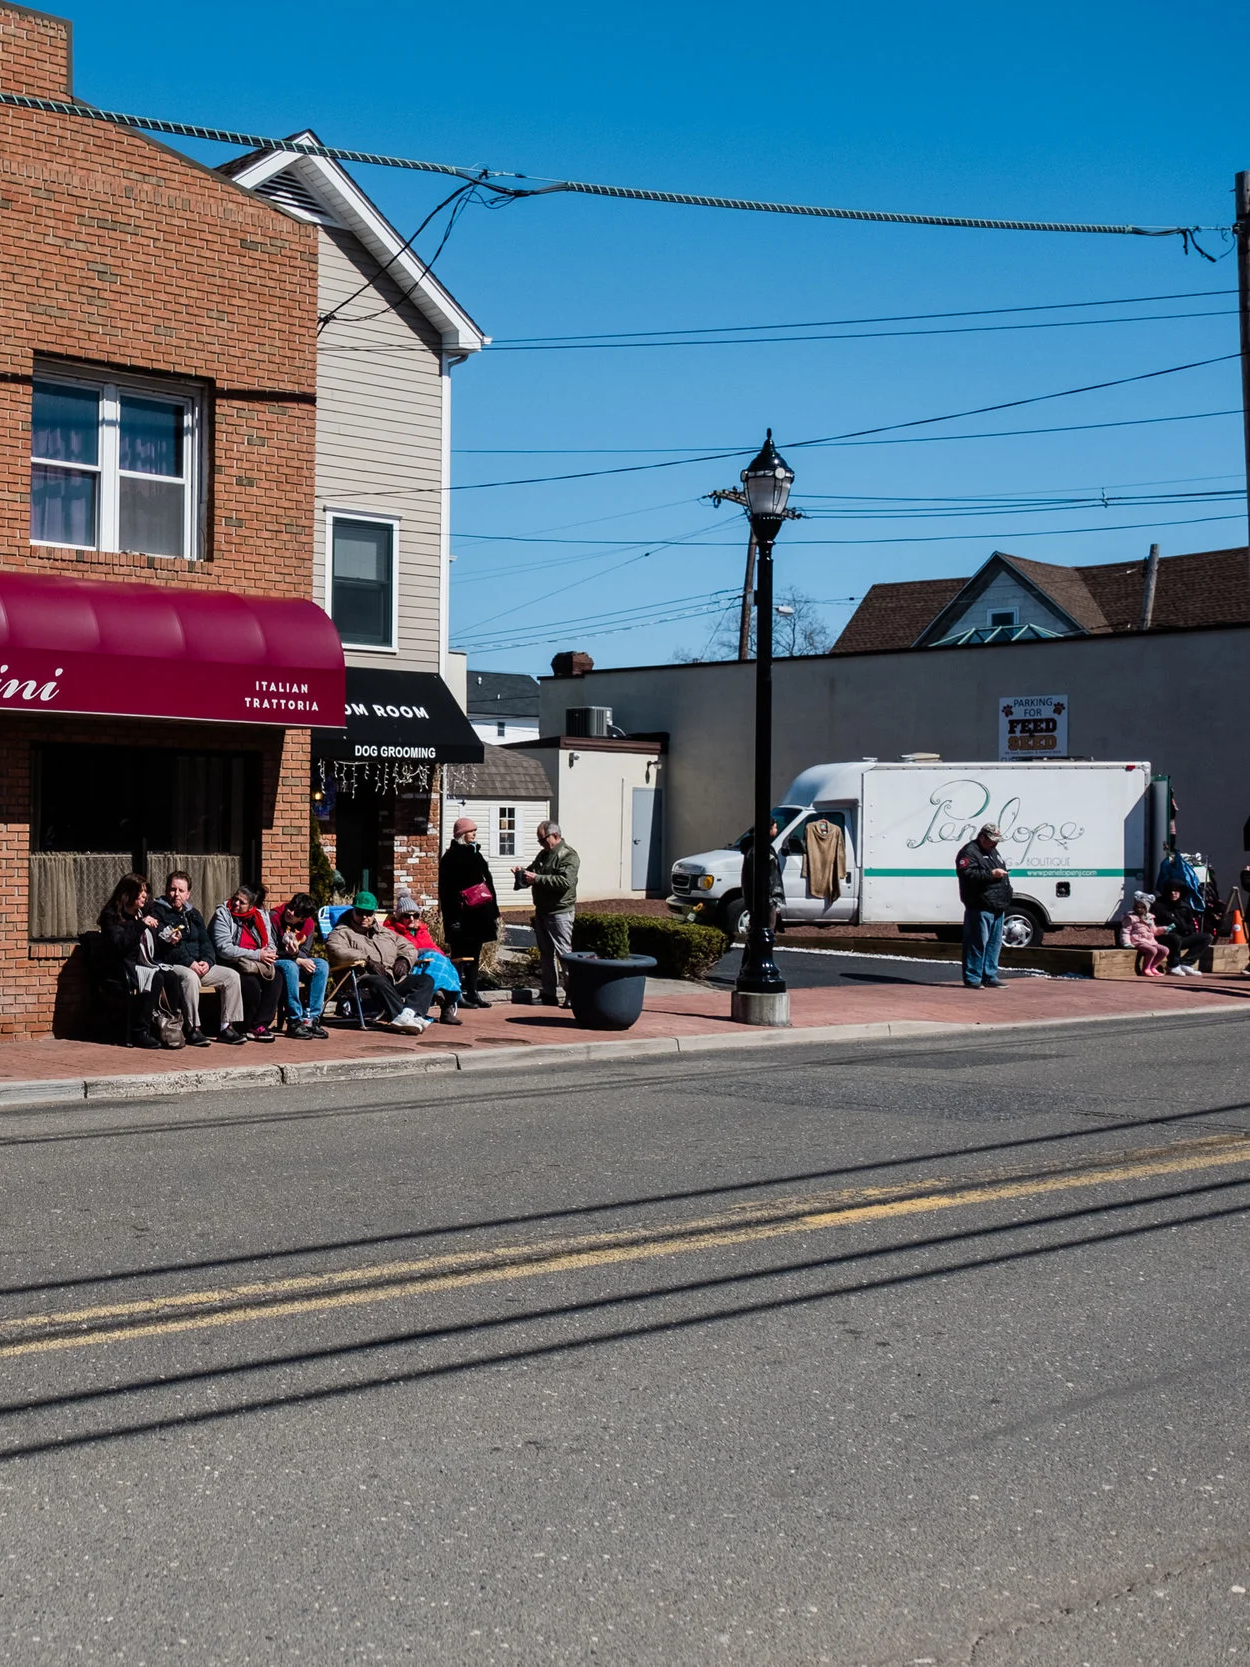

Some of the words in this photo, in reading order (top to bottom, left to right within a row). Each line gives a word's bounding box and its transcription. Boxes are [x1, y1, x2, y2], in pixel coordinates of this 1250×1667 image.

[254, 680, 309, 694] ITALIAN
[244, 696, 320, 711] TRATTORIA
[1013, 697, 1053, 708] PARKING
[372, 704, 430, 719] ROOM
[1023, 708, 1042, 717] FOR
[1007, 718, 1057, 735] FEED
[1007, 734, 1057, 751] SEED
[354, 744, 378, 757] DOG
[380, 745, 437, 759] GROOMING
[906, 779, 1085, 865] Penlope
[1026, 857, 1071, 867] BOUTIQUE
